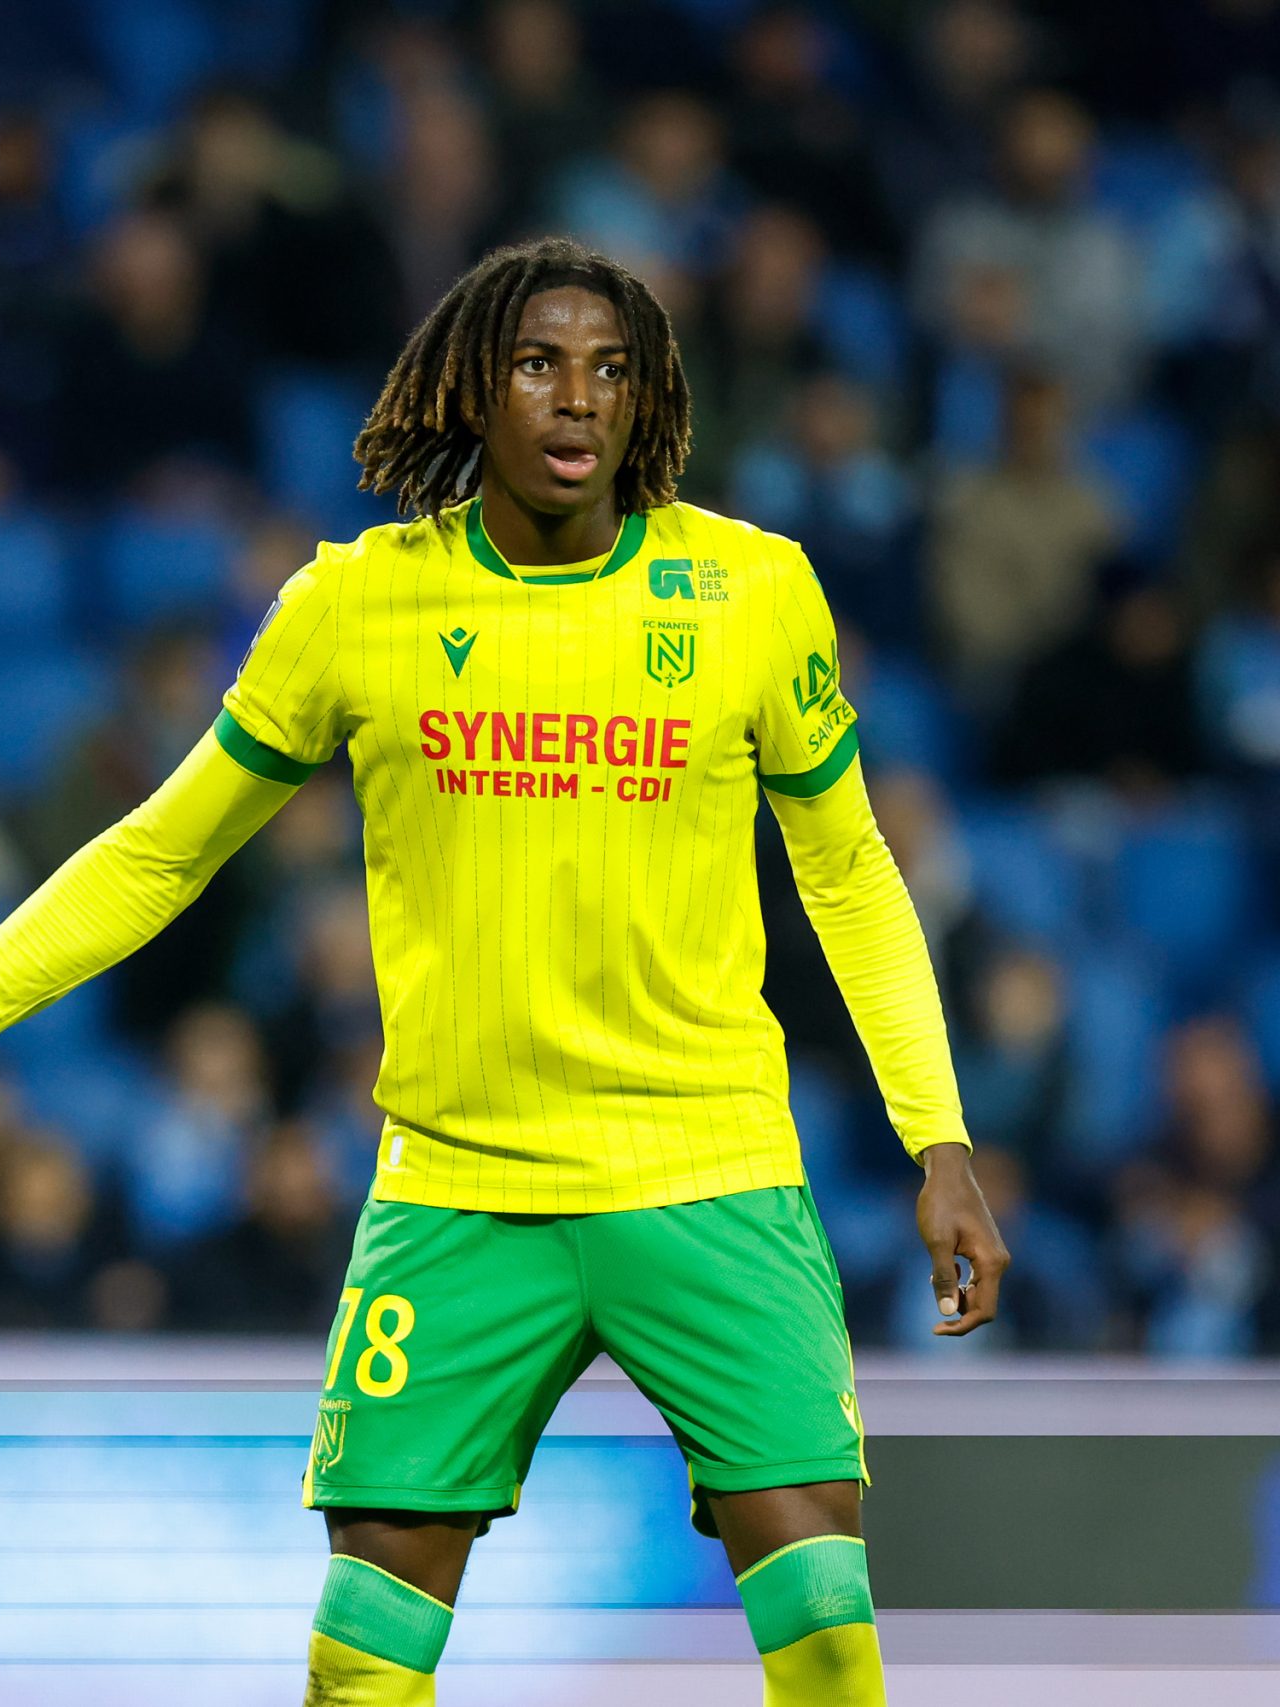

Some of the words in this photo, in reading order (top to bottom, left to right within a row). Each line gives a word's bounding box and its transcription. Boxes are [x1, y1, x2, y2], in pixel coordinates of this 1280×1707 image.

[697, 559, 718, 569] LES
[698, 569, 729, 579] GARS
[699, 580, 722, 590] DES
[700, 591, 730, 602] EAUX
[642, 620, 656, 629] FC
[657, 621, 699, 631] NANTES
[419, 709, 691, 769] SYNERGIE
[436, 768, 579, 799] INTERIM
[617, 775, 672, 802] CDI
[324, 1286, 415, 1398] 78
